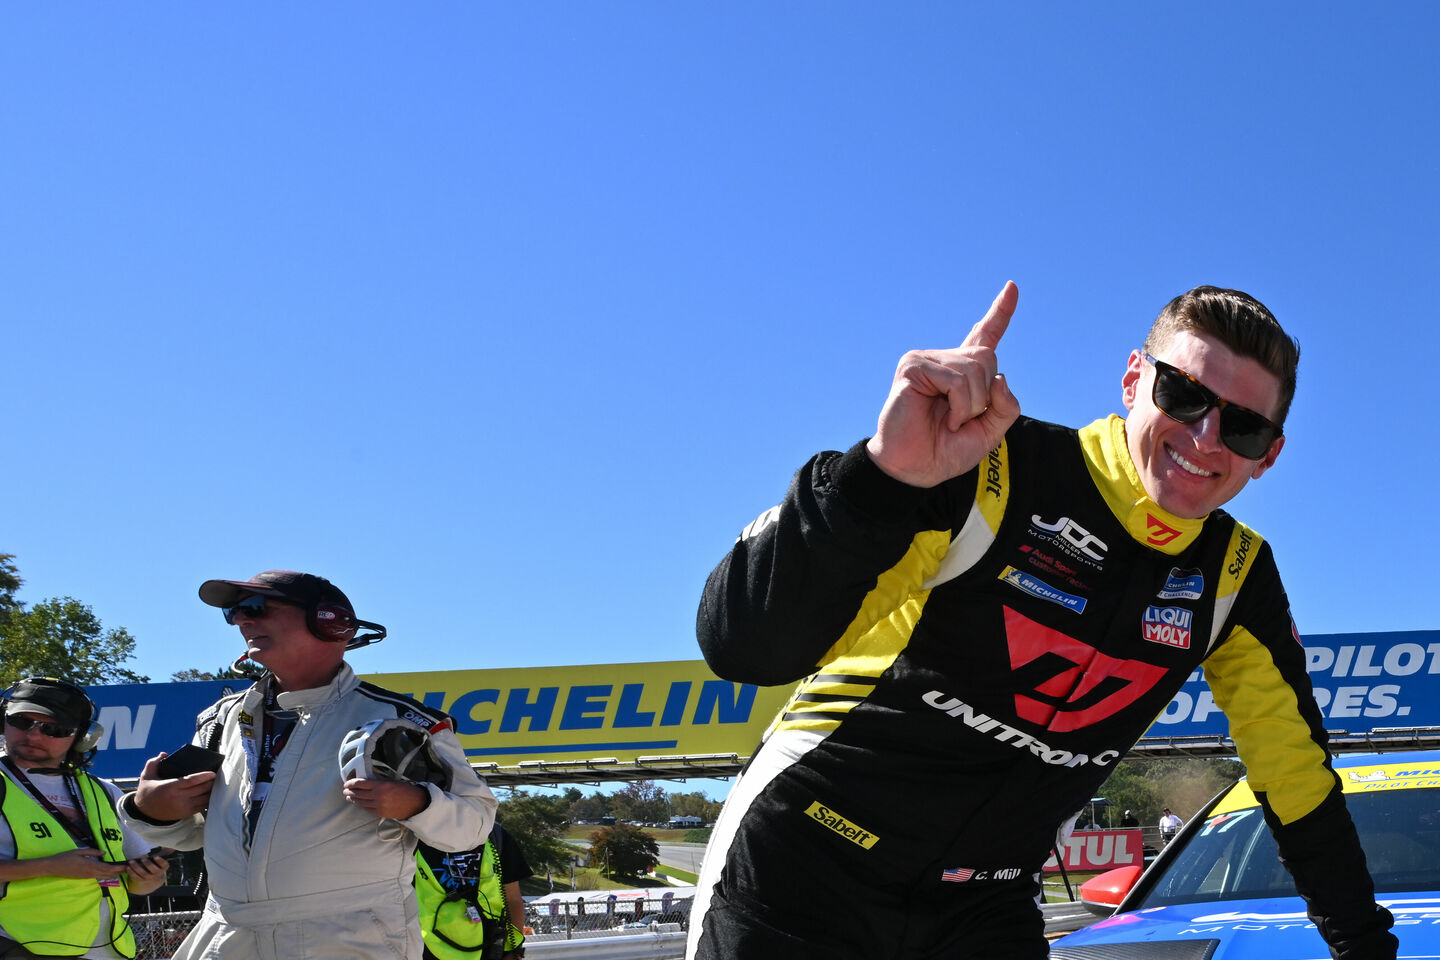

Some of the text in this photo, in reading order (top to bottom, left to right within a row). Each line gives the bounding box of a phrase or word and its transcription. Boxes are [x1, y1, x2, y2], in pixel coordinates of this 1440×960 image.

[986, 443, 1003, 498] abelt
[1027, 529, 1103, 571] MOTORSPORTS
[1055, 534, 1081, 555] MILLER
[1228, 529, 1252, 580] Sabelt
[1021, 578, 1078, 606] MICHELIN
[1145, 606, 1190, 628] LIQUI
[1146, 623, 1189, 646] MOLY
[1320, 684, 1411, 719] RES.
[404, 711, 430, 728] OMP
[921, 690, 1120, 768] UNITRONC
[29, 822, 52, 838] 91
[813, 806, 872, 846] Sabelt
[1043, 834, 1134, 867] OTUL
[994, 868, 1021, 880] Mill
